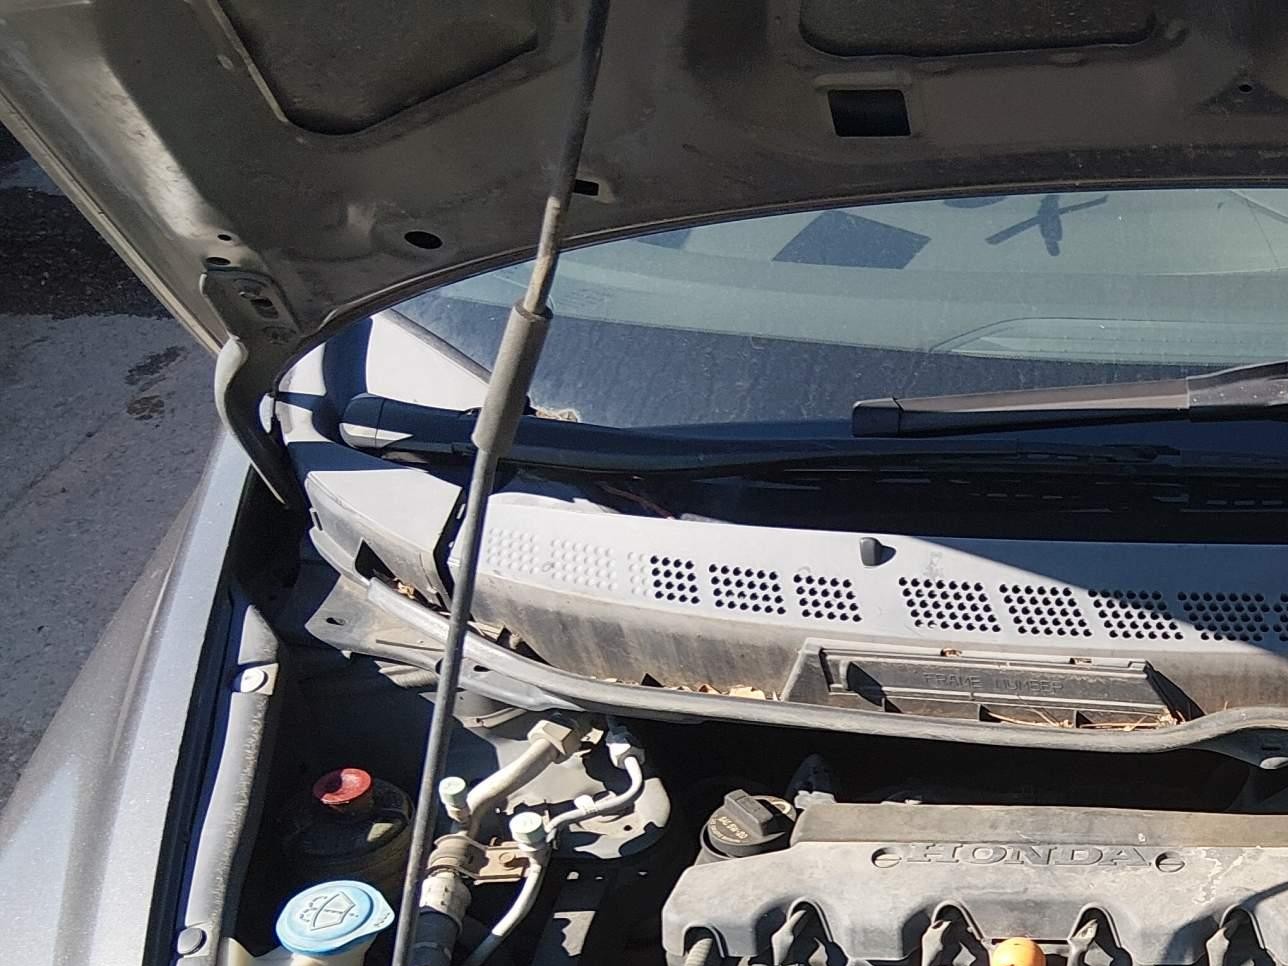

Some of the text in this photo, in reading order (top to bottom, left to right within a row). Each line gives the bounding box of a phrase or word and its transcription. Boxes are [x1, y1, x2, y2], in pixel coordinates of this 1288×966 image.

[922, 671, 1065, 696] FRAME NUMBER
[906, 842, 1152, 867] HONDA
